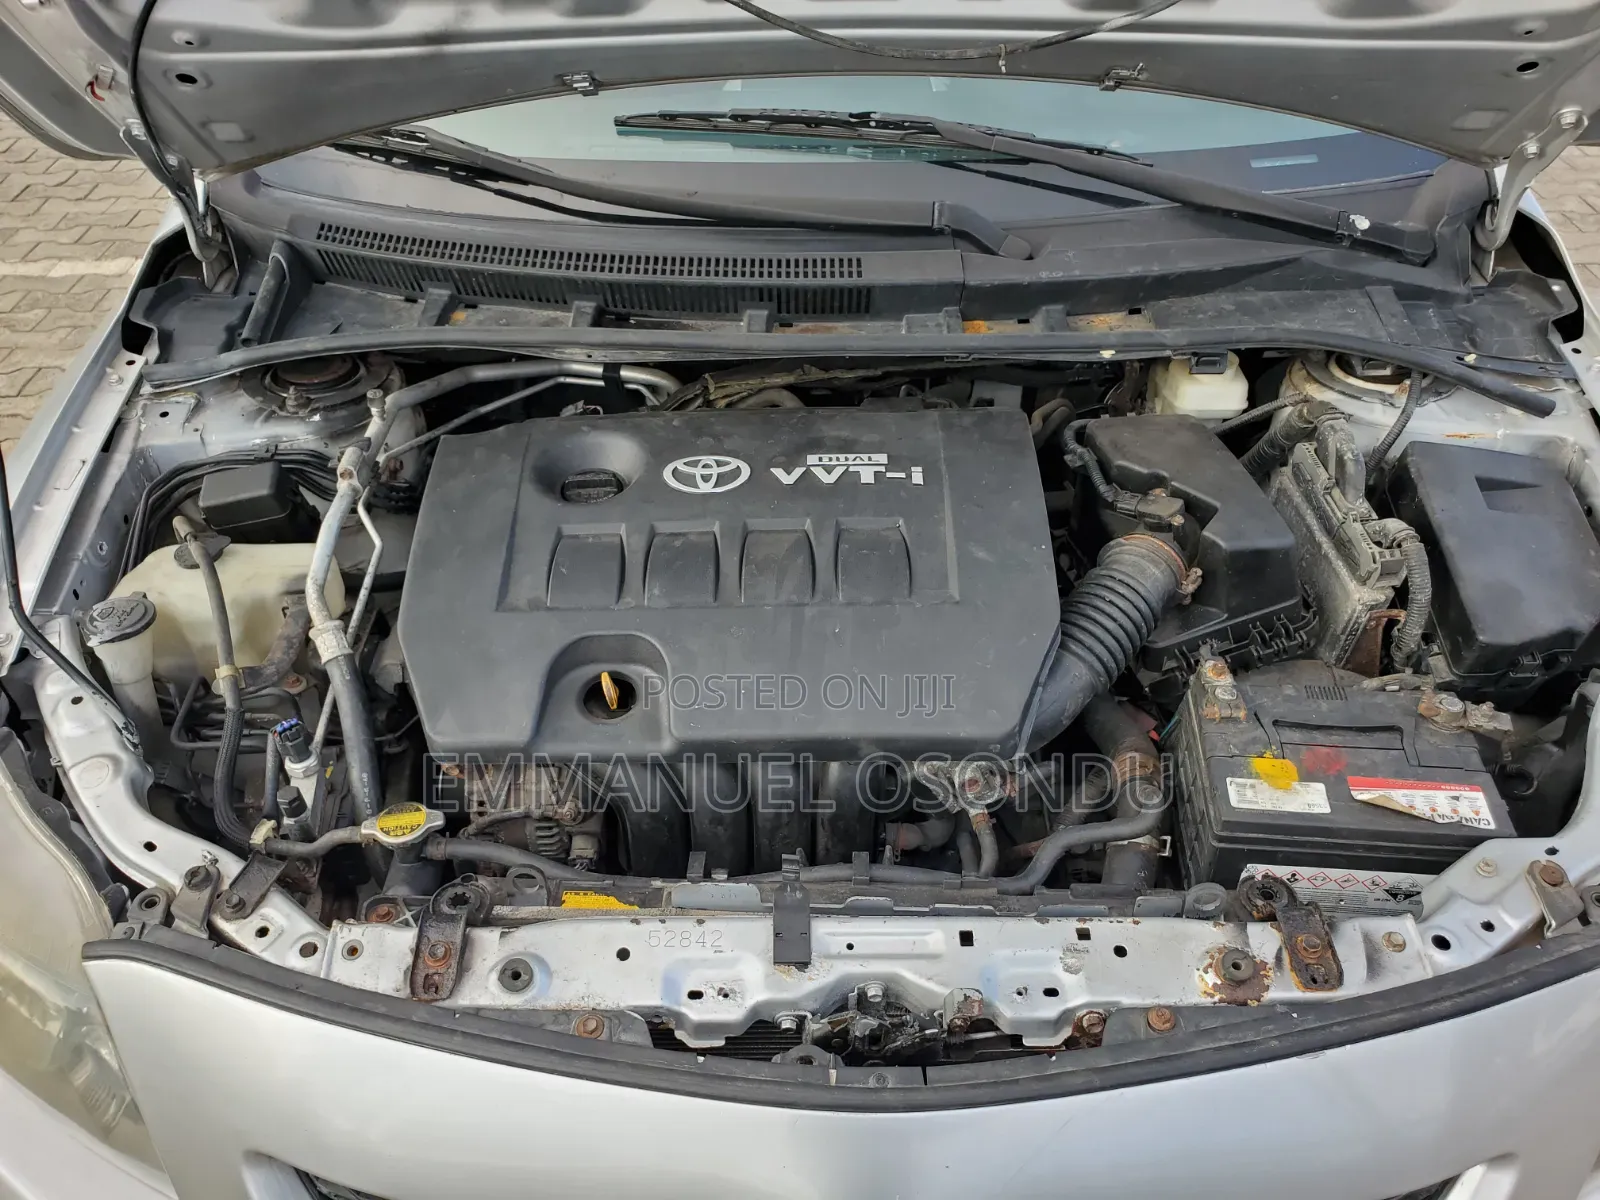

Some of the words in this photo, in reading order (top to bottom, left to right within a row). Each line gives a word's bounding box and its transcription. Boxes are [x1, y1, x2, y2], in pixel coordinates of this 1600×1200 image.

[815, 455, 884, 463] DUAL
[770, 466, 924, 485] VVT-i
[1395, 894, 1405, 902] 8
[648, 930, 723, 948] 52842
